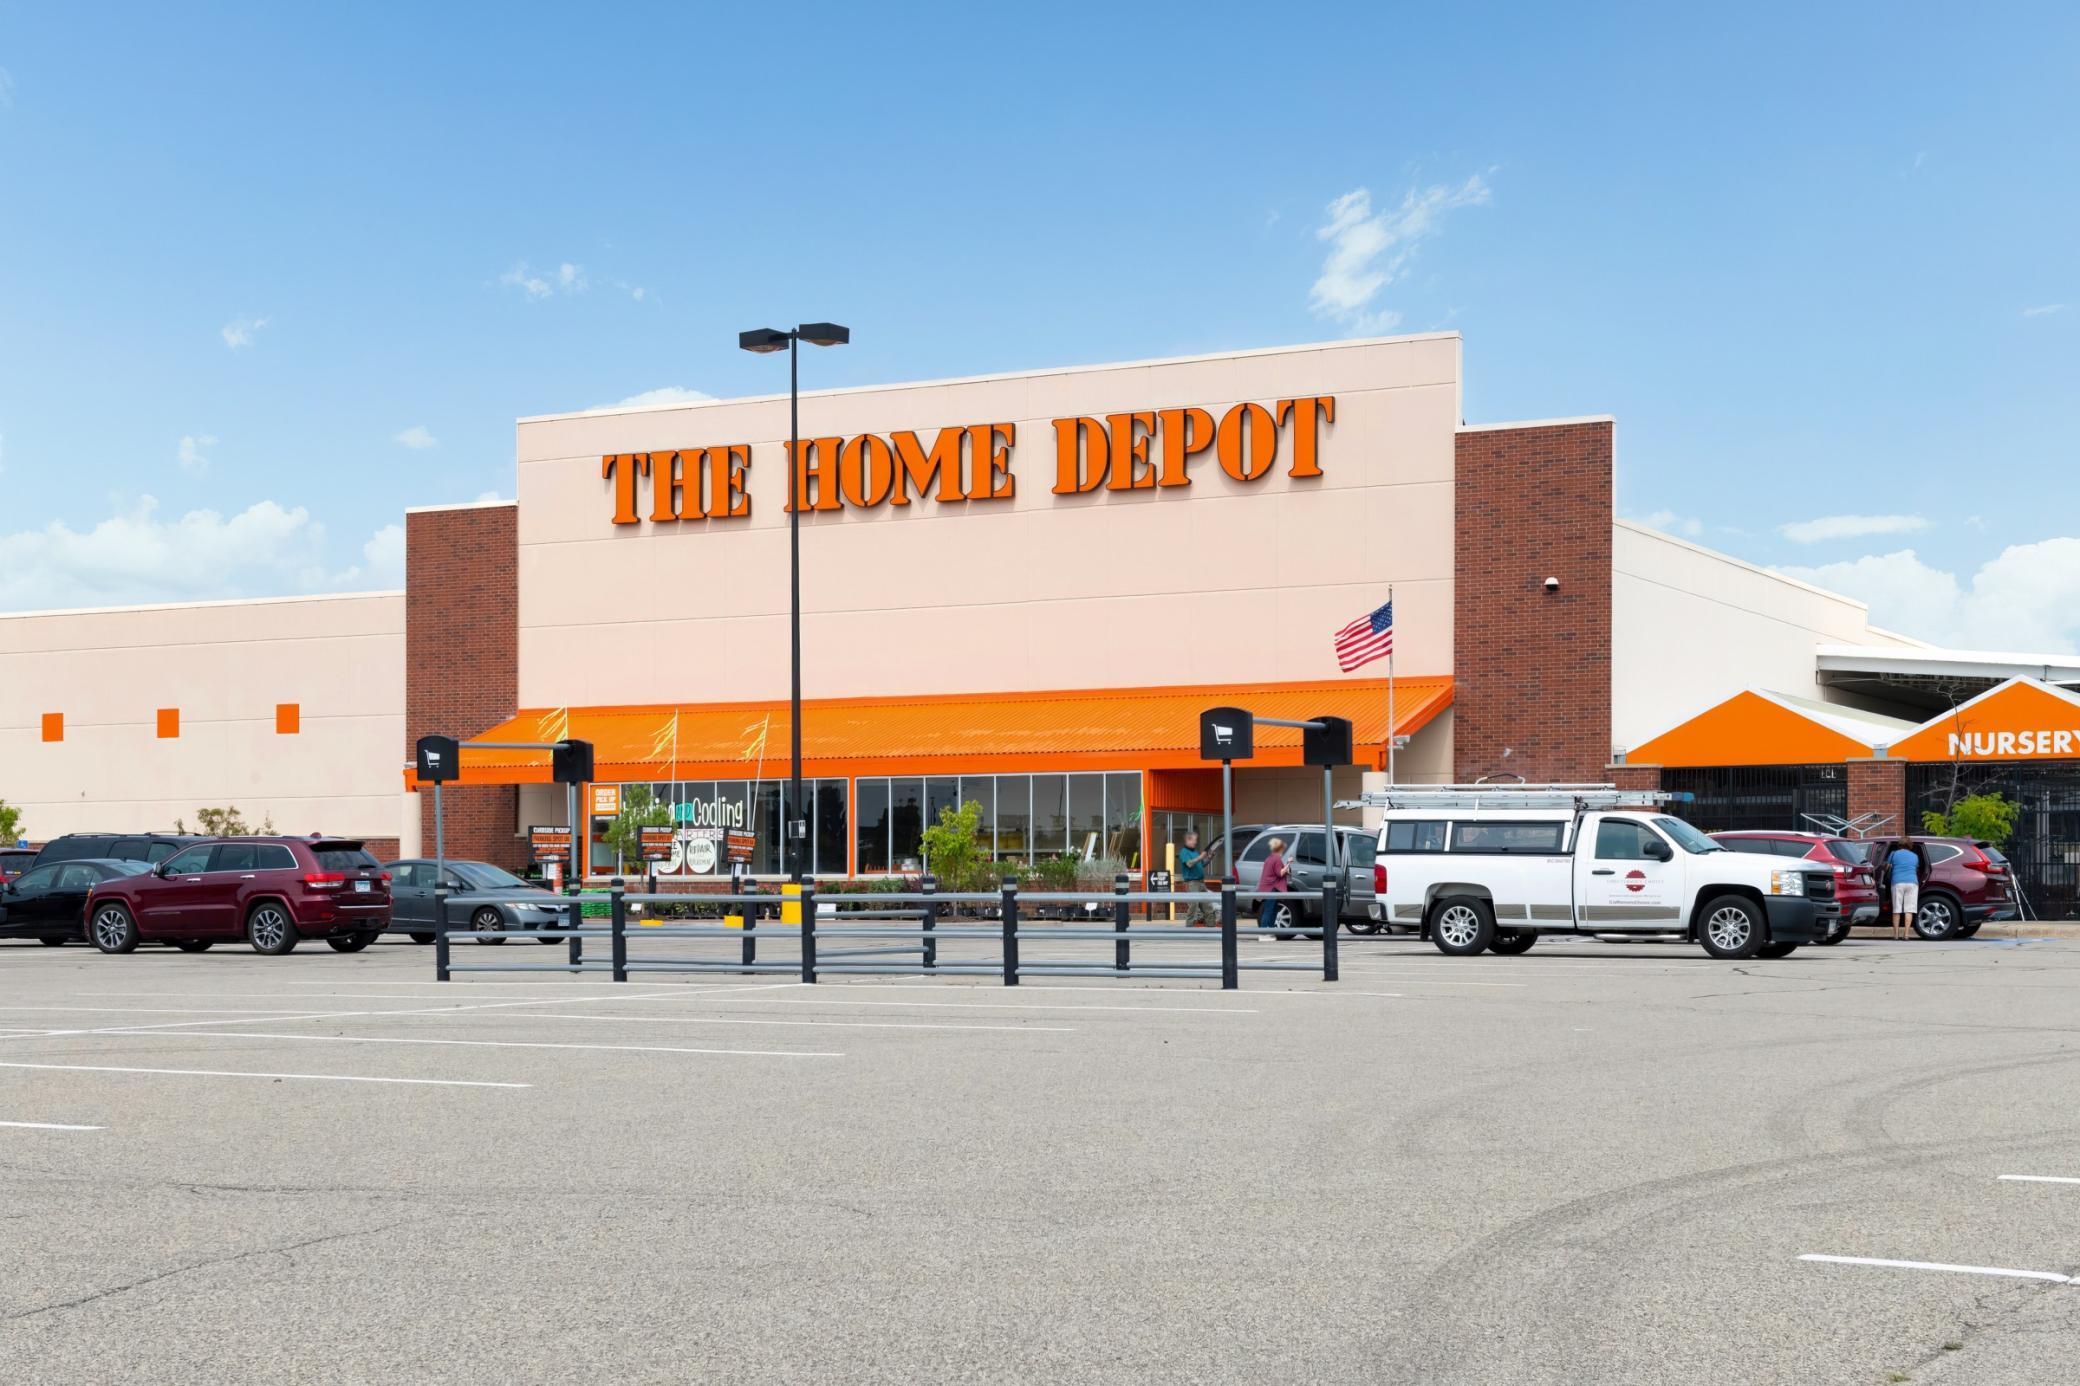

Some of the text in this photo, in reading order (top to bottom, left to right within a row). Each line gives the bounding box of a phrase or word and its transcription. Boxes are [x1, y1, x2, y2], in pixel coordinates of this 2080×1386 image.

[602, 395, 1336, 525] THE HOME DEPOT
[693, 796, 743, 827] Cooling
